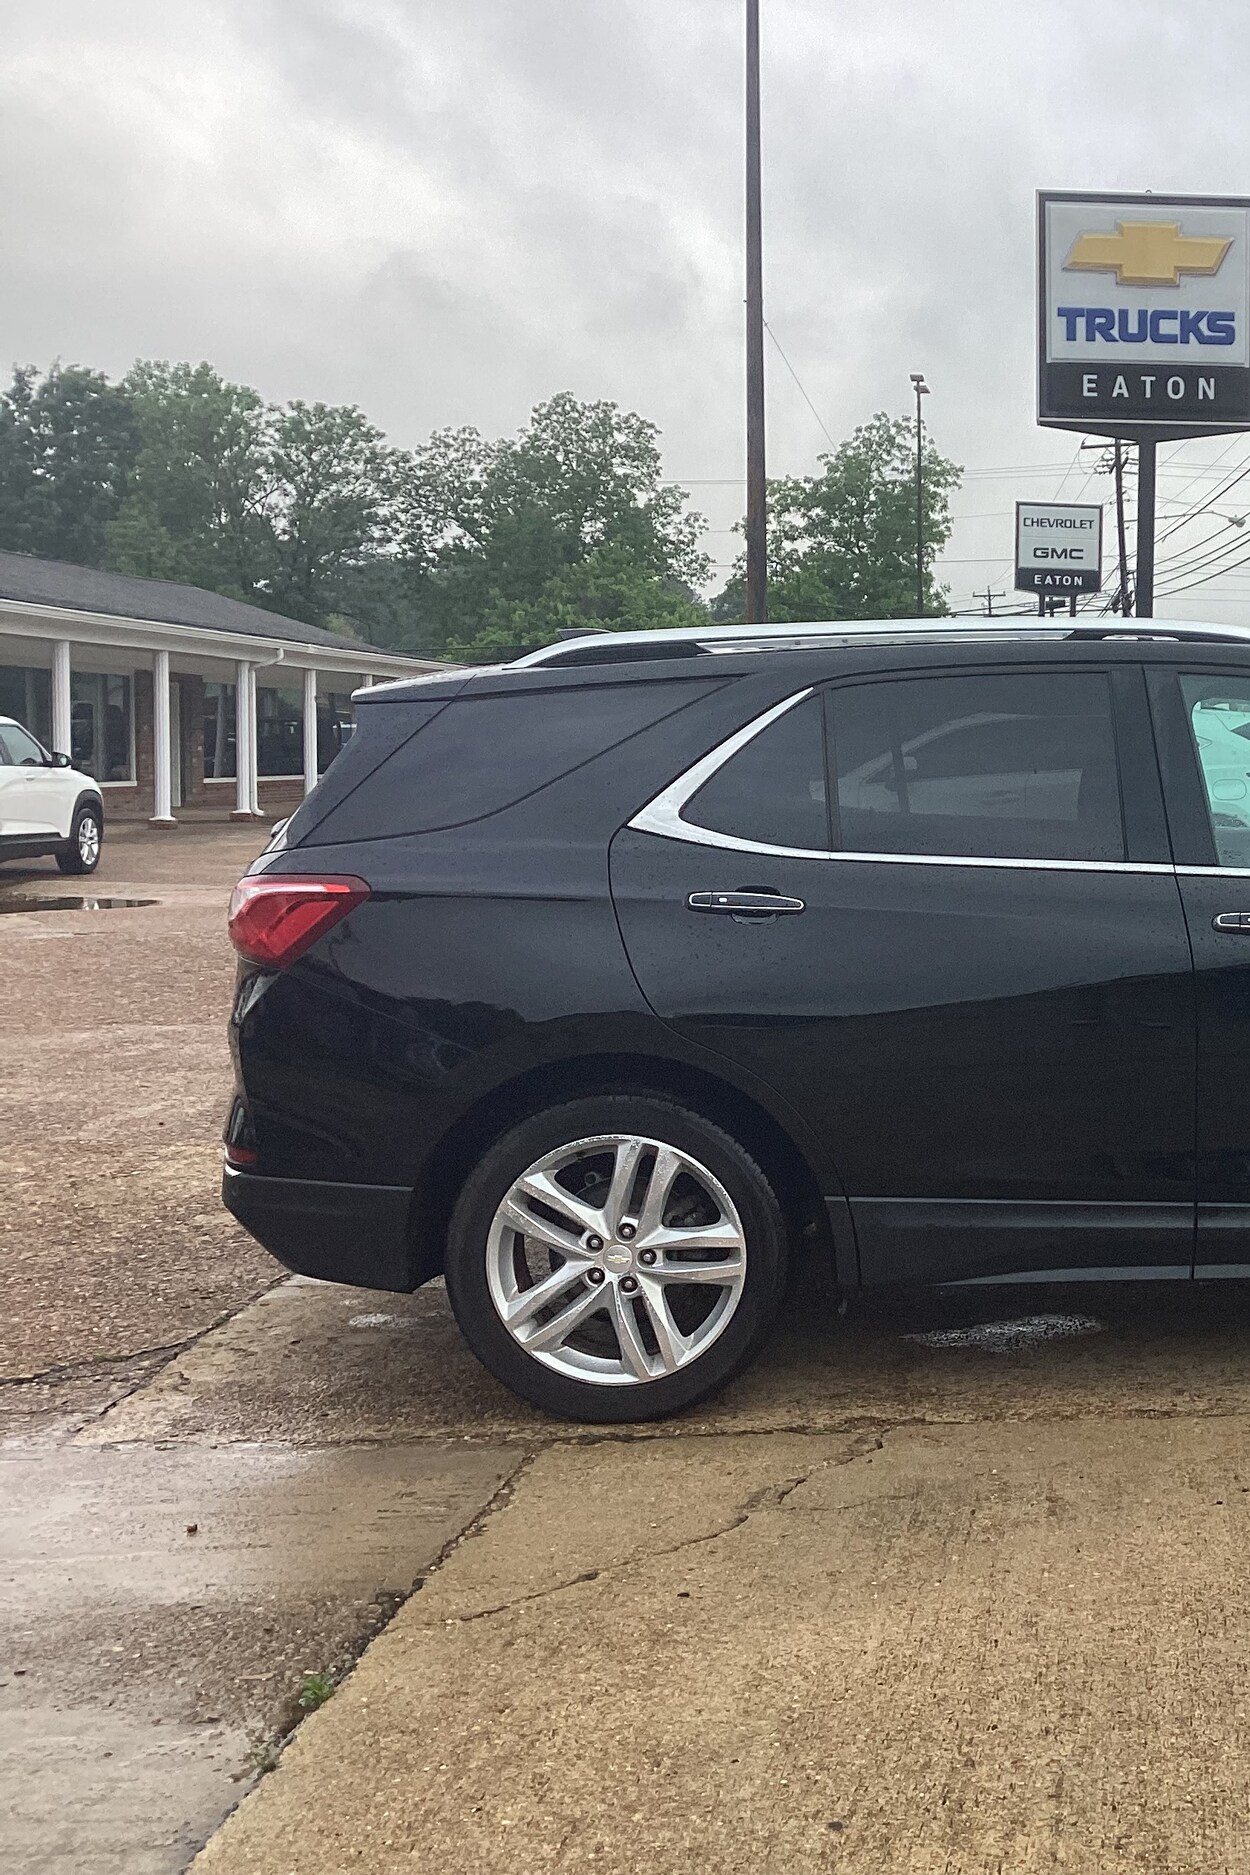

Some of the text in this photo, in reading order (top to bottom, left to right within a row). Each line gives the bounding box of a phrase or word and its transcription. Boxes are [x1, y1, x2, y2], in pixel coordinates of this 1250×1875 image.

[1057, 307, 1236, 346] TRUCKS
[1082, 374, 1216, 400] EATON
[1023, 517, 1095, 529] CHEVROLET
[1033, 547, 1084, 560] GMC
[1034, 574, 1083, 586] EATON
